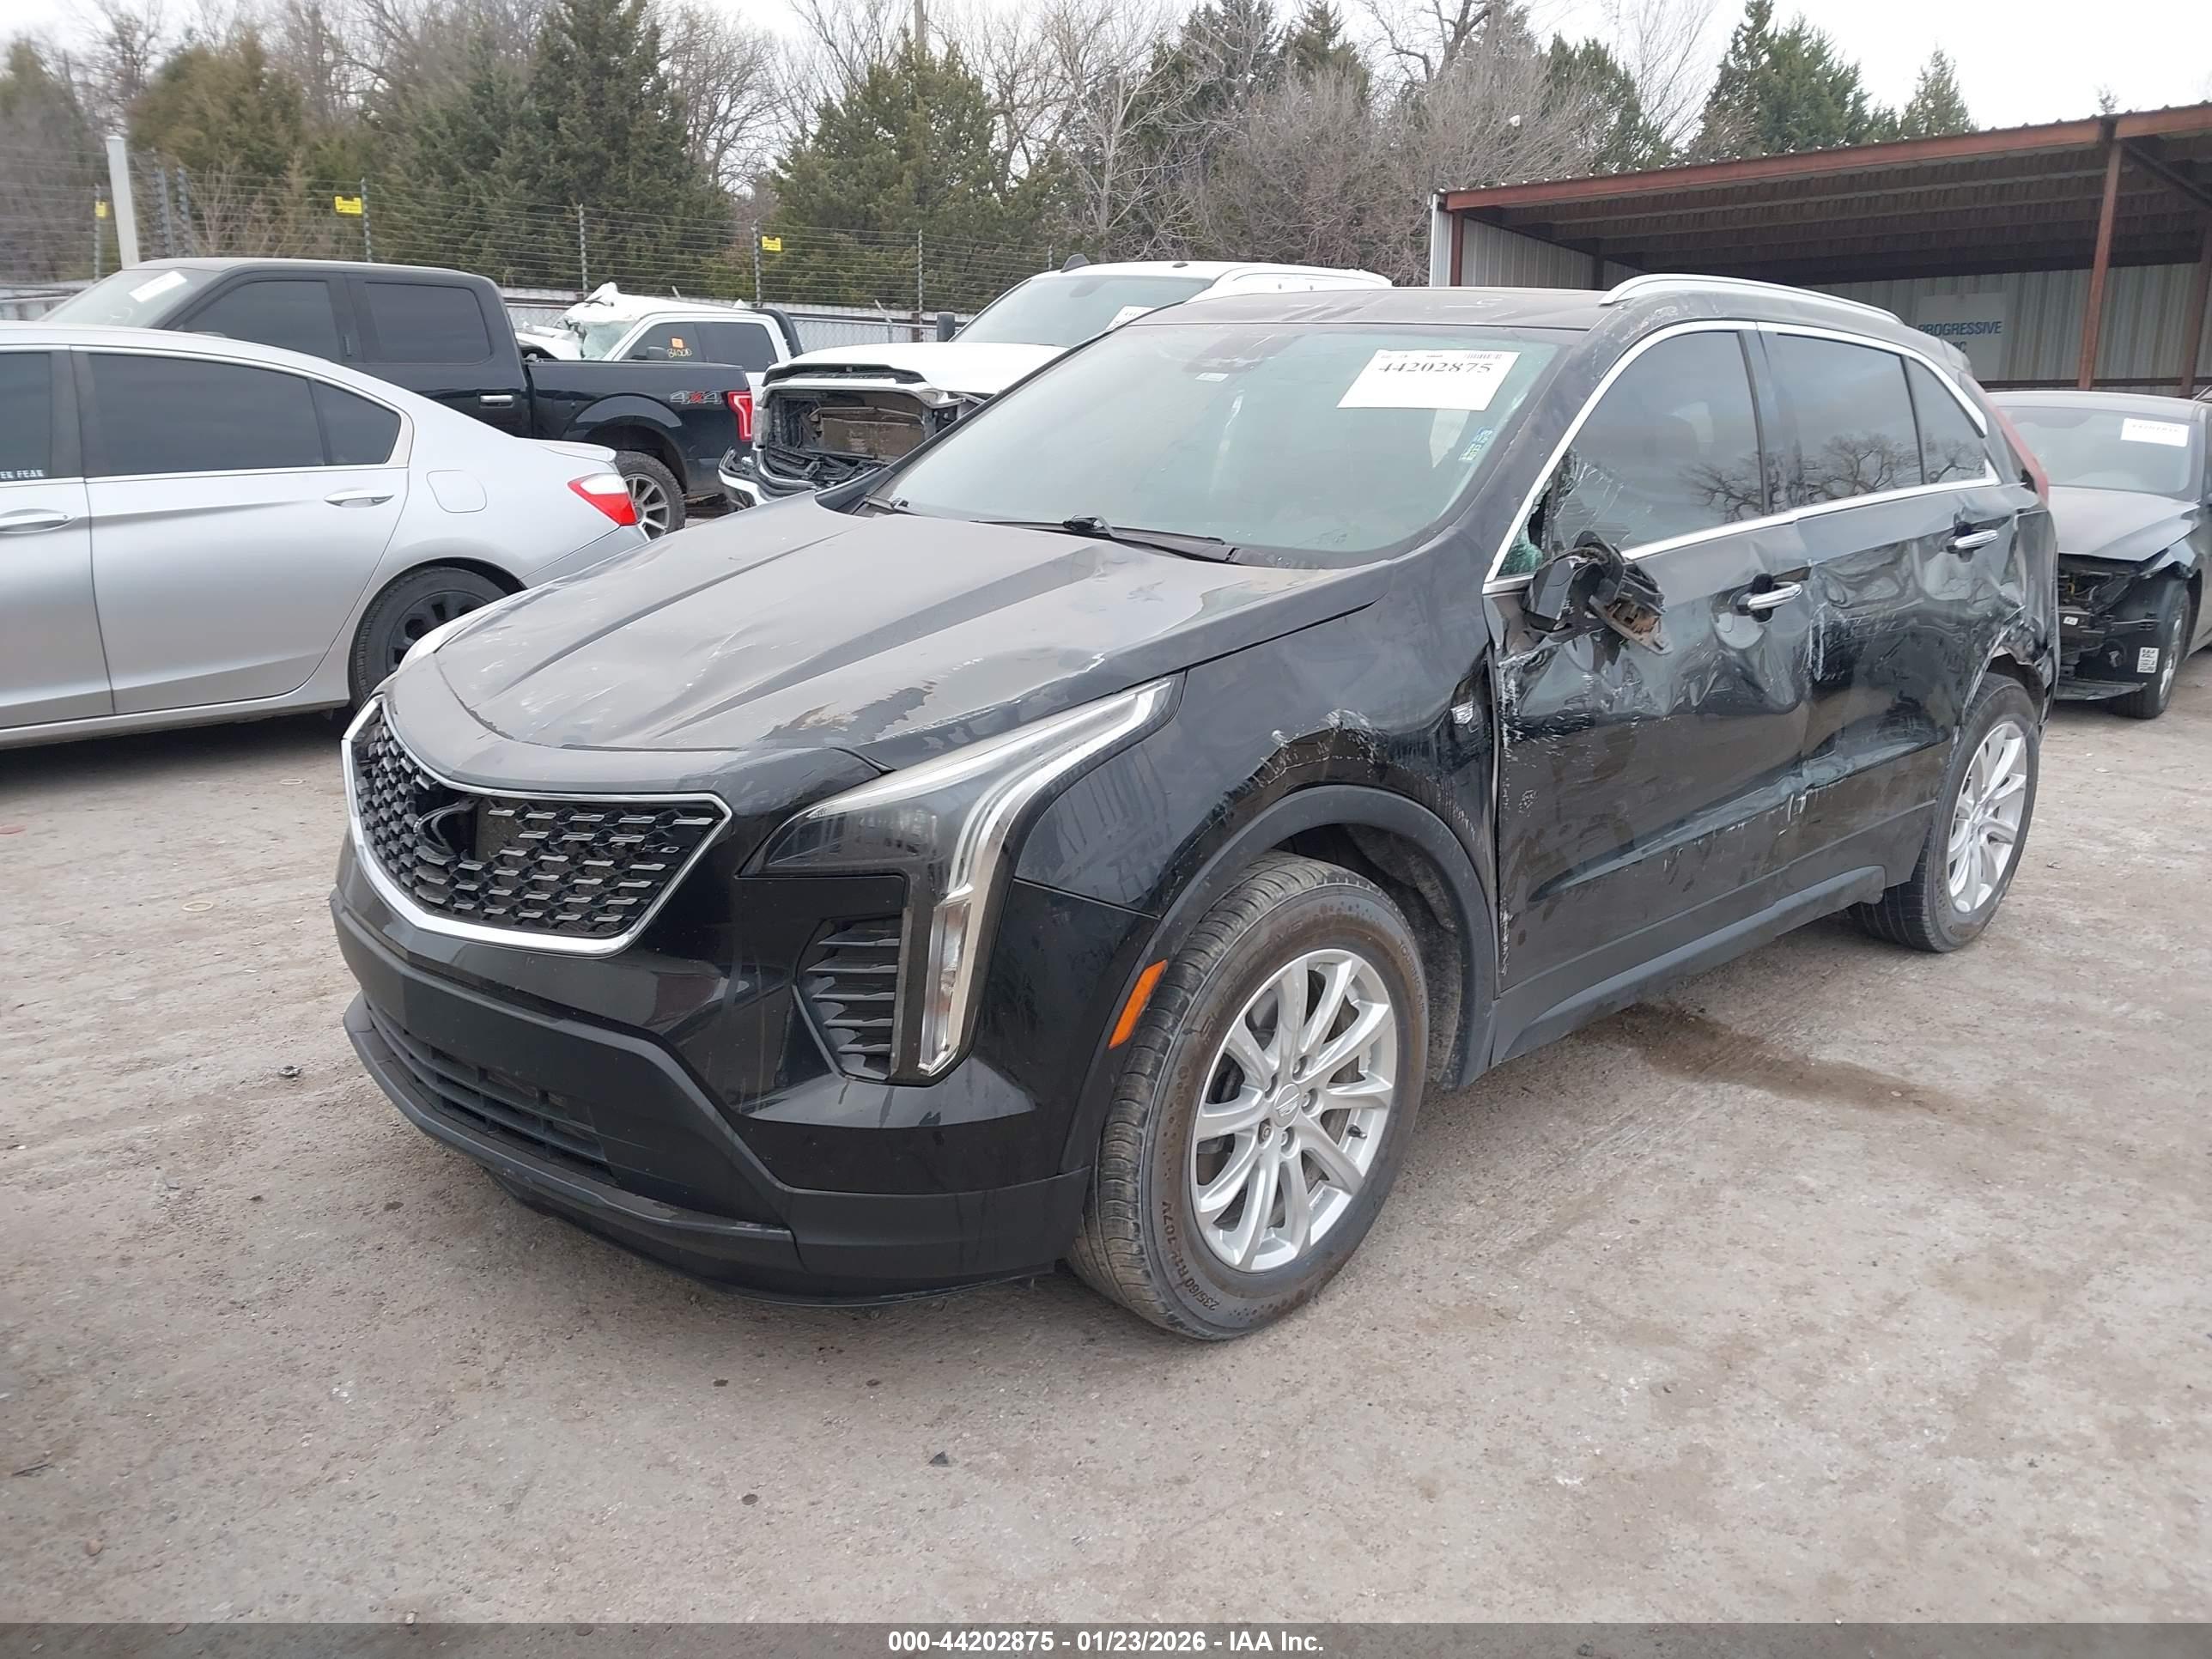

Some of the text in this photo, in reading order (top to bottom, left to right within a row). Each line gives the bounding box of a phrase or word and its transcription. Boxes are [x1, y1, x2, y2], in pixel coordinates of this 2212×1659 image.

[1917, 321, 2002, 337] PROGRESSIVE
[1378, 362, 1494, 373] 44202875
[1161, 1200, 1177, 1245] 107V
[1184, 1277, 1220, 1311] 235/60
